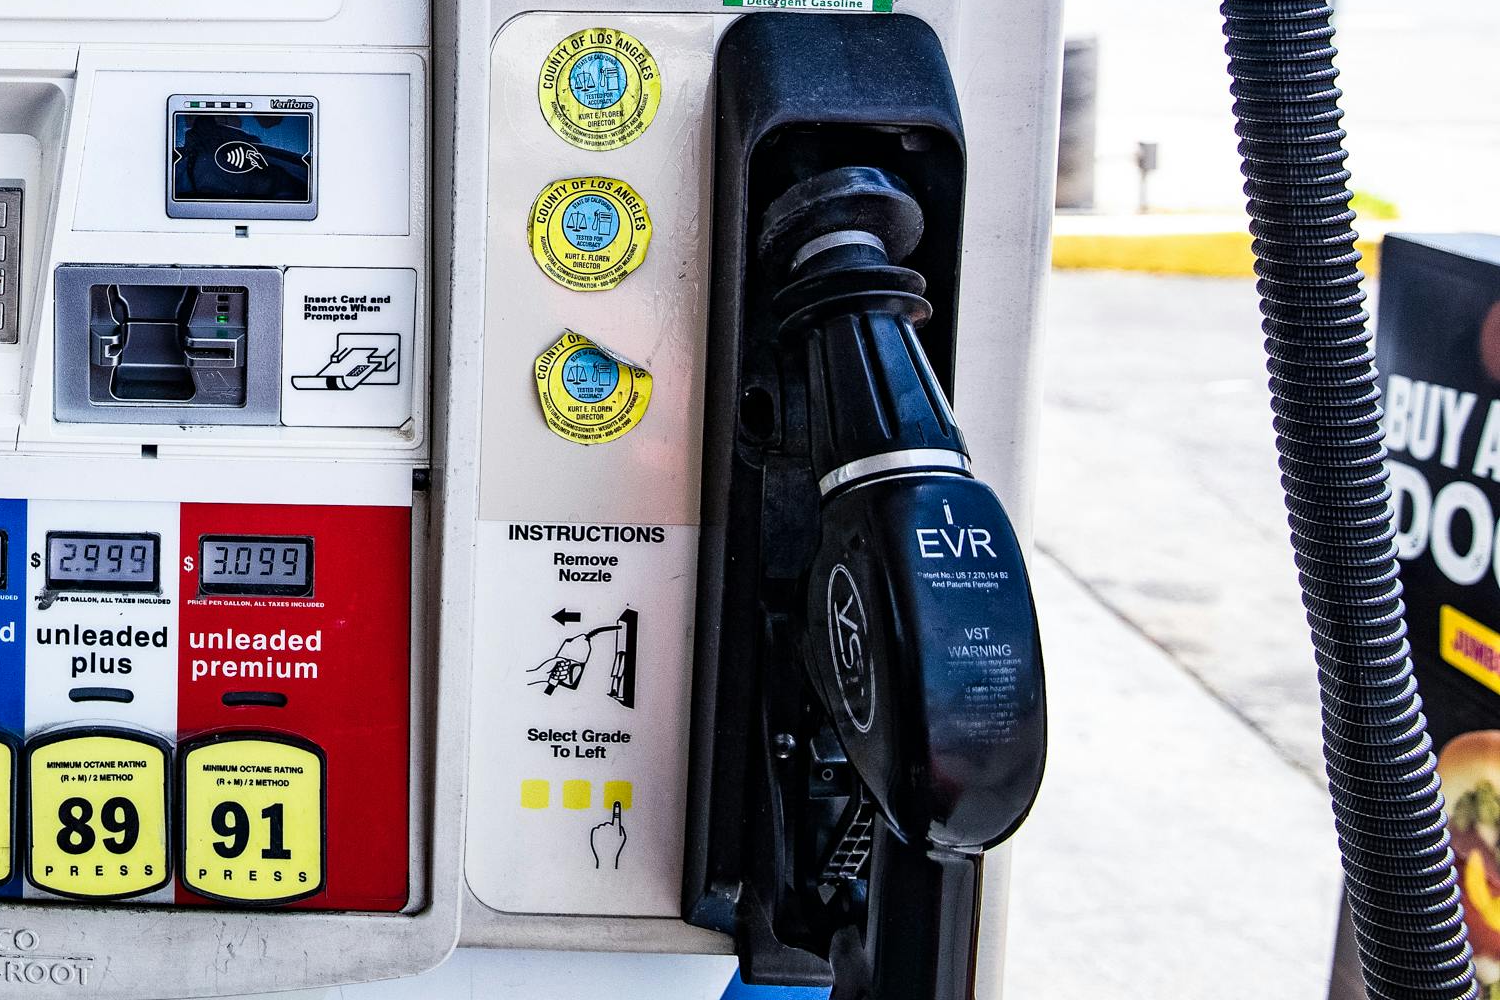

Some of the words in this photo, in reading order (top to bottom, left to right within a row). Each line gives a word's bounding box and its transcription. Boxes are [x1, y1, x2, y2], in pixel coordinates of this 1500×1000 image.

[270, 100, 313, 109] Verifone
[536, 184, 568, 224] COUNTY
[571, 180, 587, 190] OF
[590, 179, 614, 191] LOS
[613, 186, 646, 231] ANGELES
[304, 295, 337, 304] Insert
[341, 295, 367, 304] Card
[370, 295, 391, 304] and
[304, 304, 347, 312] Remove
[350, 304, 381, 312] When
[304, 313, 358, 321] Prompted
[1386, 374, 1478, 469] BUY
[508, 524, 665, 543] INSTRUCTIONS
[916, 528, 997, 558] EVR
[59, 543, 145, 574] 2.999
[213, 546, 299, 576] 3.099
[553, 551, 619, 568] Remove
[558, 569, 612, 583] Nozzle
[36, 625, 169, 648] unleaded
[189, 628, 322, 651] unleaded
[964, 627, 990, 640] VST
[948, 644, 1012, 658] WARNING
[71, 653, 134, 678] plus
[192, 656, 318, 681] premium
[527, 728, 578, 745] Select
[582, 730, 631, 745] Grade
[550, 745, 568, 759] To
[571, 745, 607, 760] Left
[56, 796, 140, 856] 89
[210, 801, 292, 860] 91
